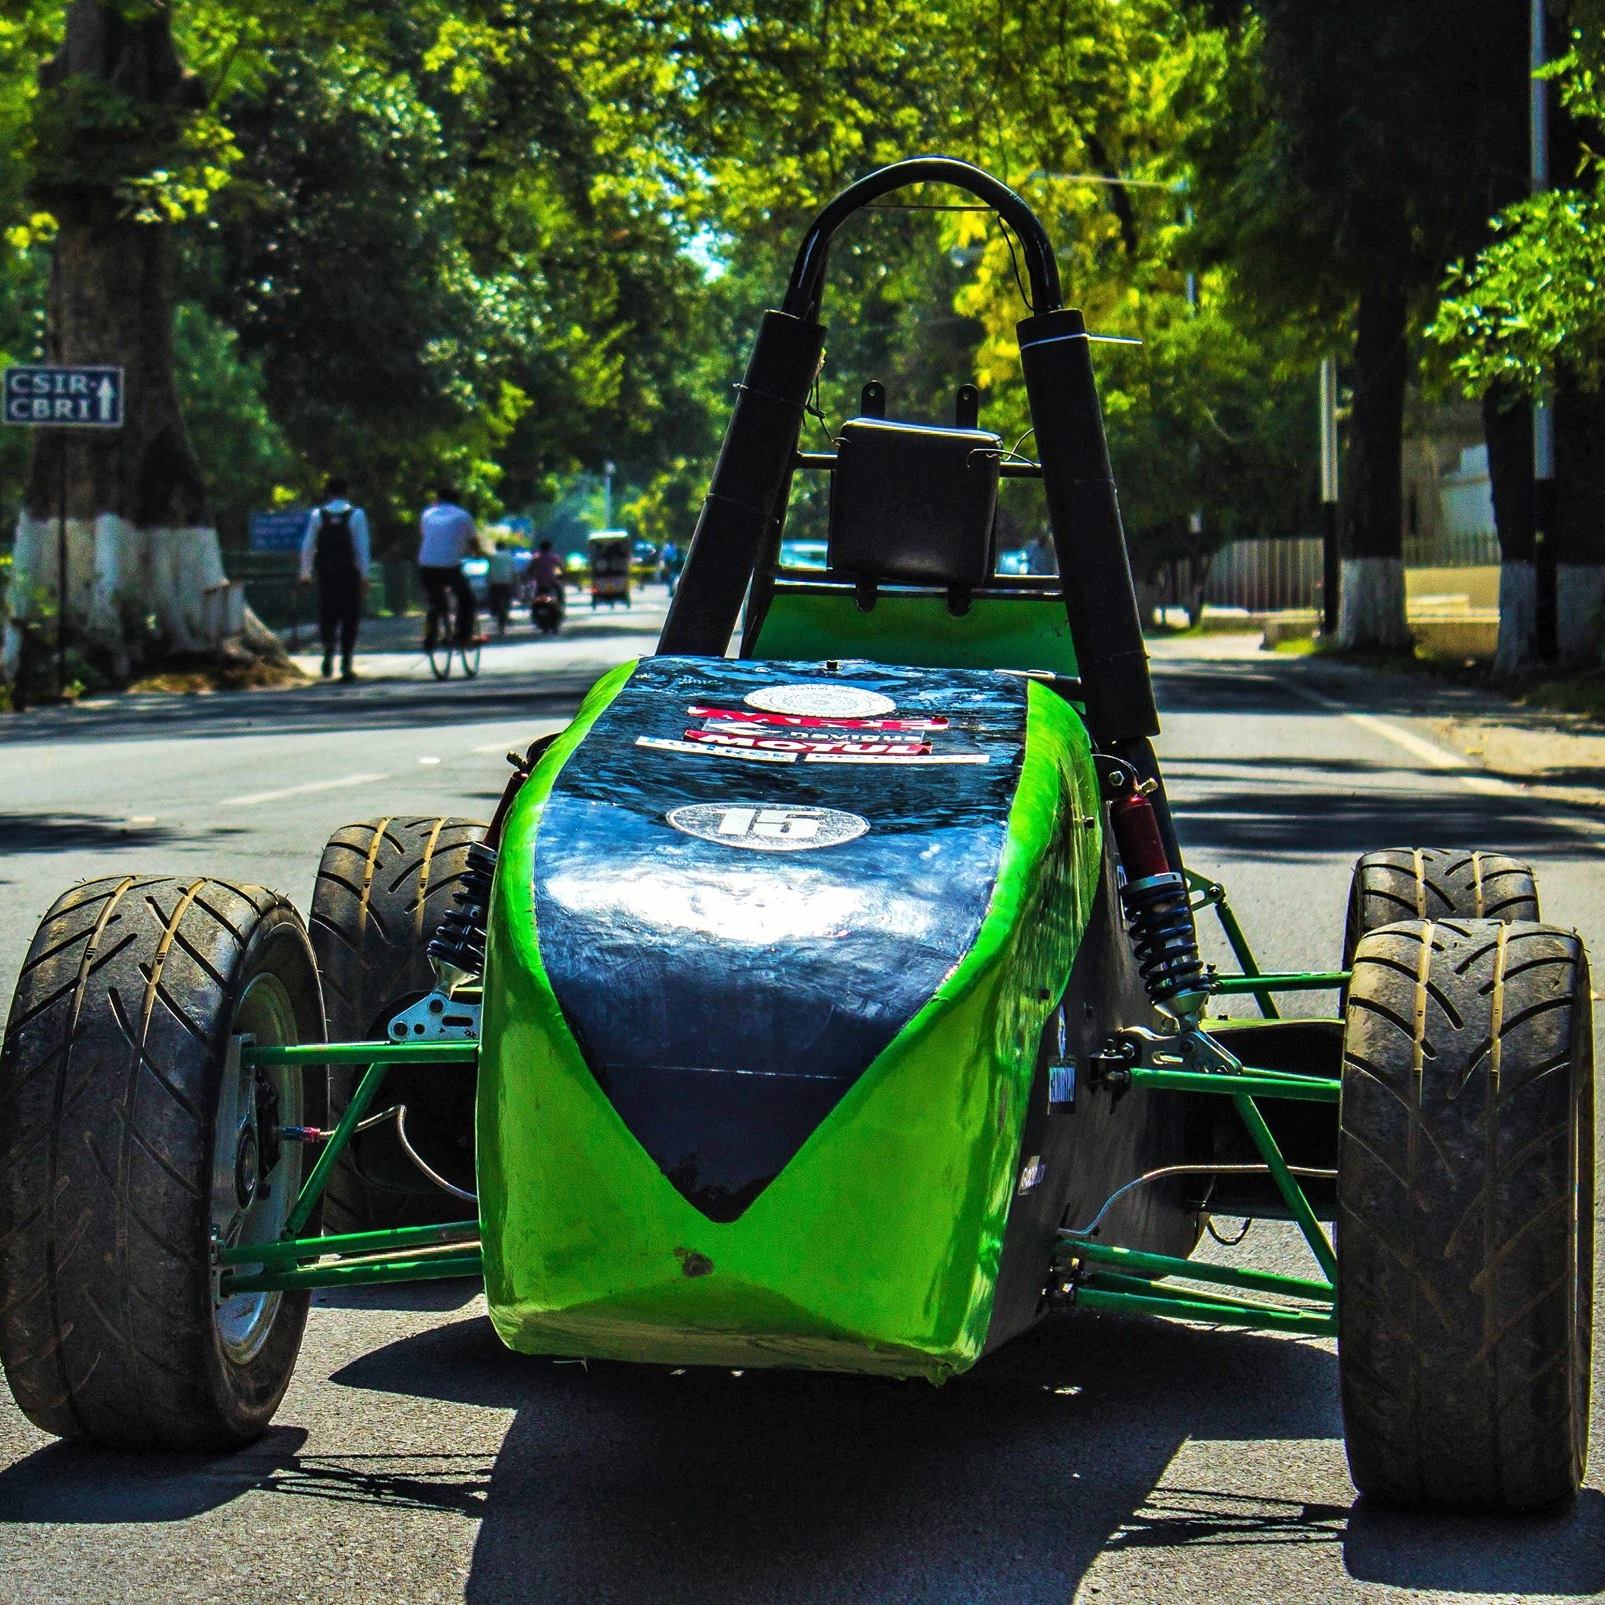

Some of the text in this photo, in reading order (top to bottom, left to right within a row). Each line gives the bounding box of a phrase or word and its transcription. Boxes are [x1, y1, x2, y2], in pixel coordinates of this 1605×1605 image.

[10, 399, 91, 419] CBRI
[697, 734, 919, 754] MOTUL
[711, 807, 824, 839] 15
